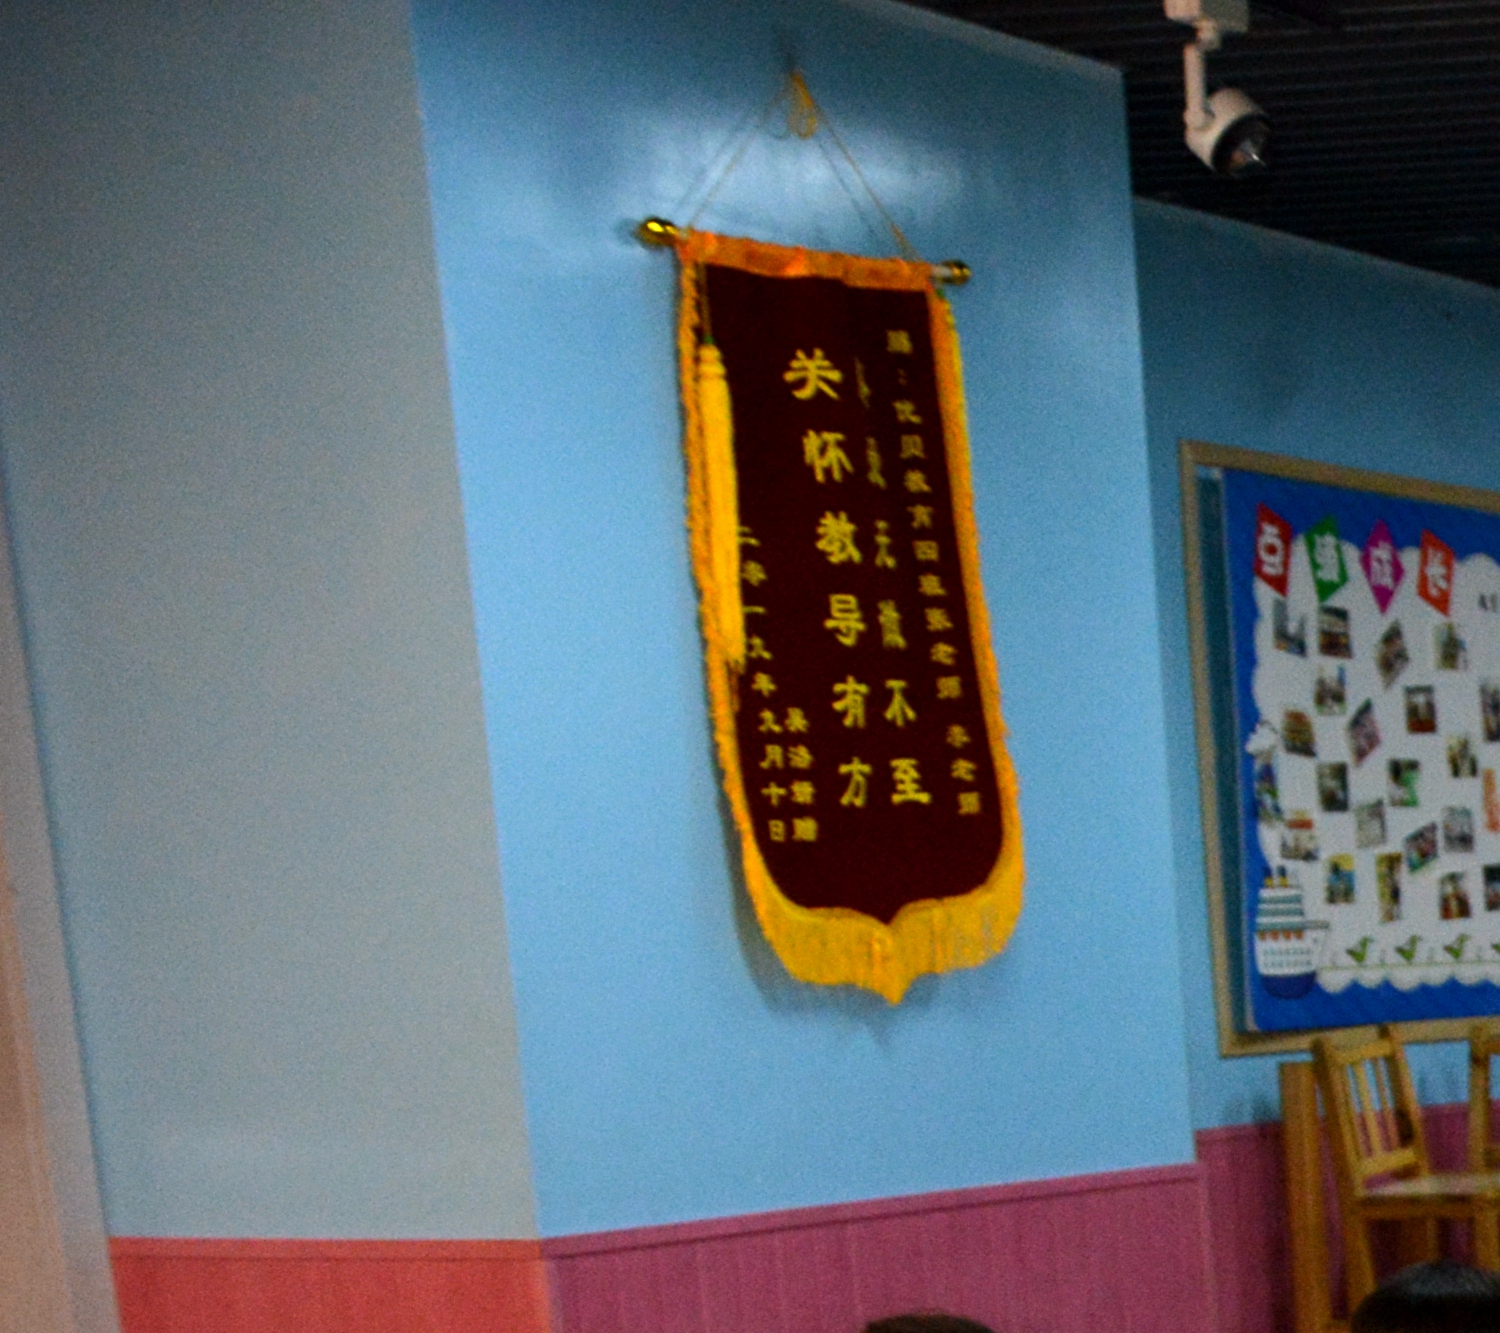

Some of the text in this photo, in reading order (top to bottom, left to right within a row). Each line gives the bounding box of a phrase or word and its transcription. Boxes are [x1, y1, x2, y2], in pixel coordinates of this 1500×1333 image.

[783, 347, 872, 808] 关怀教导有方
